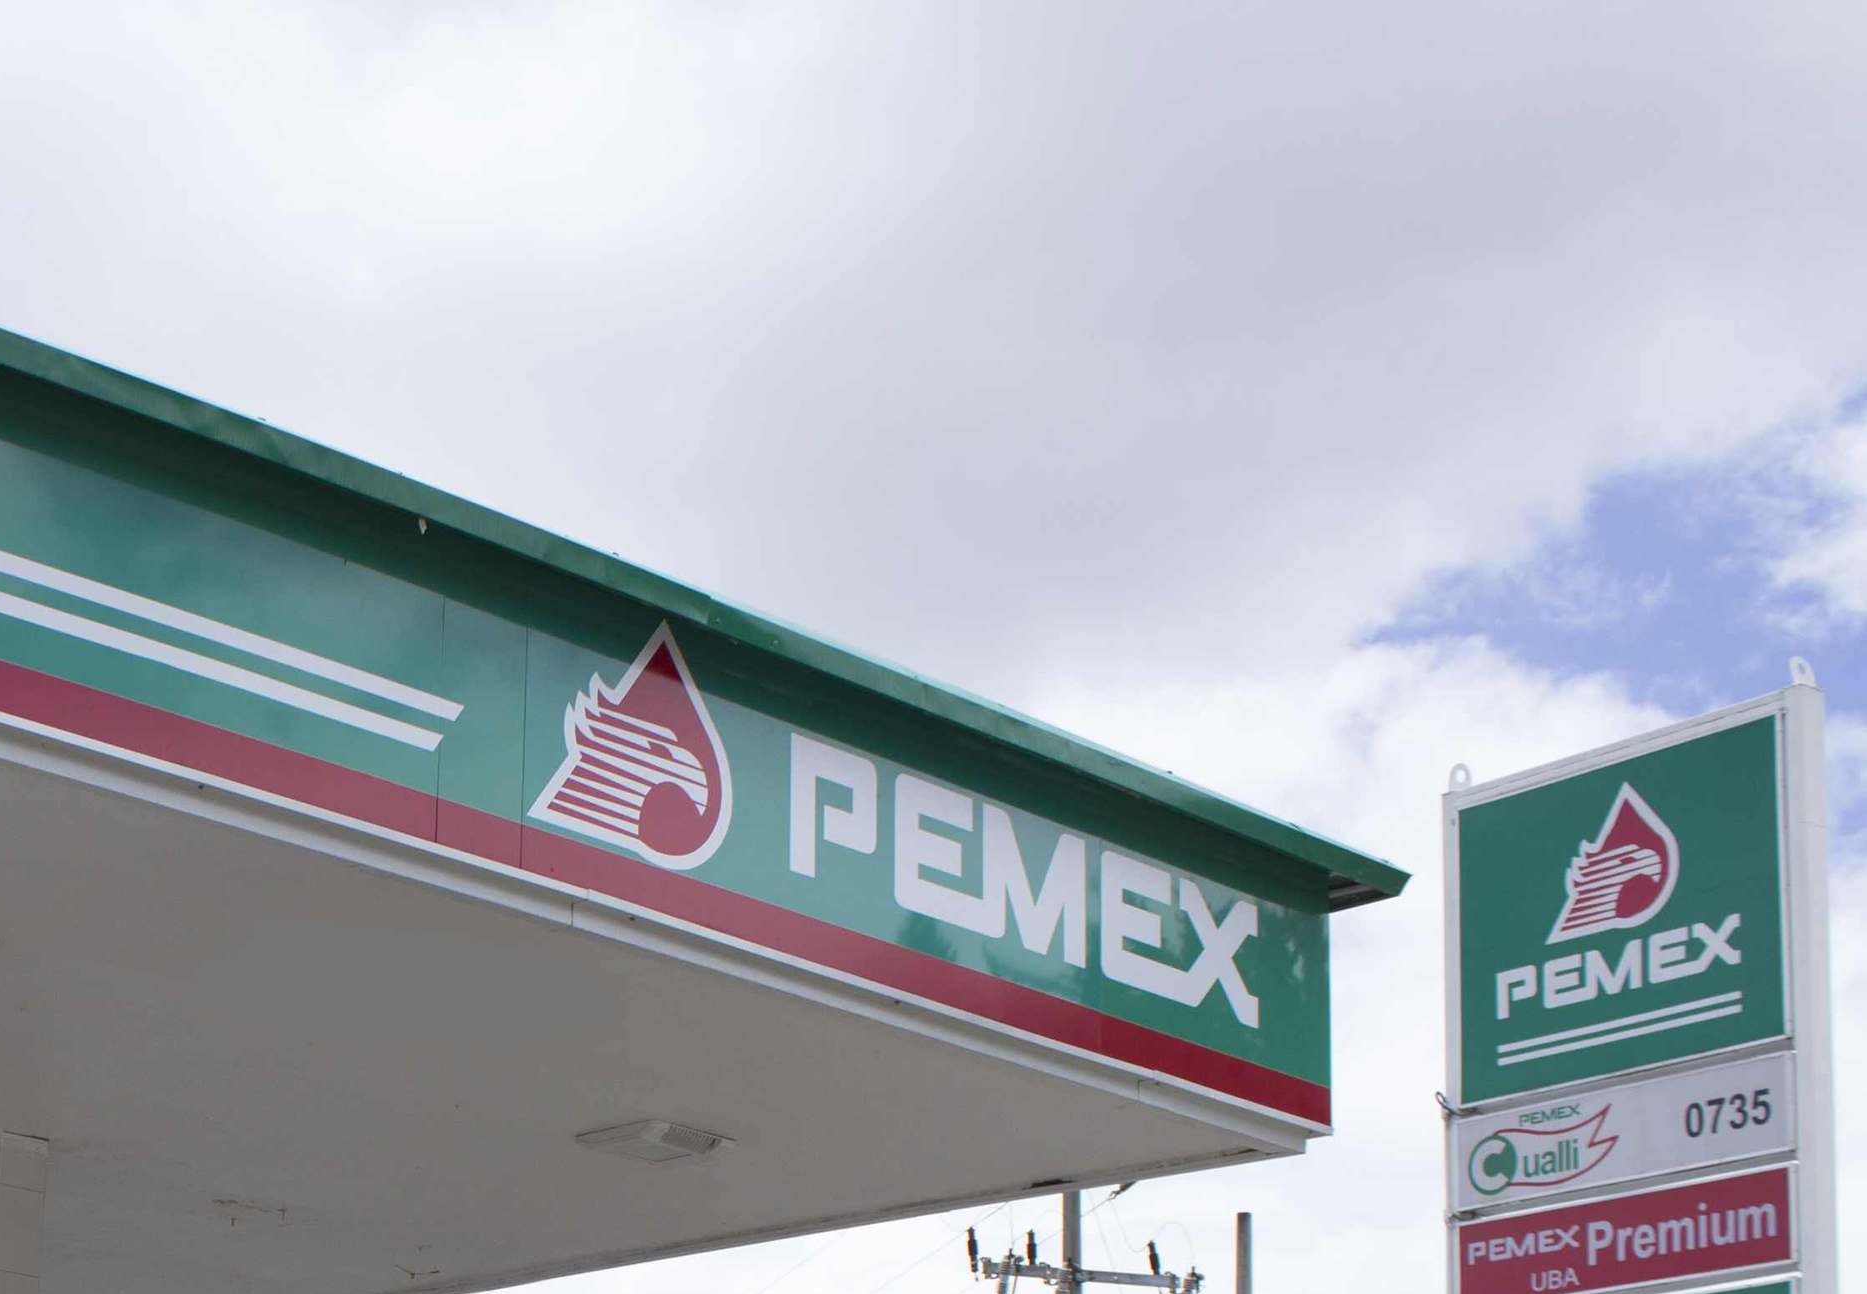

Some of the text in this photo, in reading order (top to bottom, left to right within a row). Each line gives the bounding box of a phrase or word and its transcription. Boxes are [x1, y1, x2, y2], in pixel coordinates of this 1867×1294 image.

[790, 733, 1258, 1027] PEMEX
[1496, 913, 1741, 1019] PEMEX
[1518, 1103, 1581, 1127] PEMEX
[1685, 1088, 1772, 1138] 0735
[1467, 1201, 1777, 1266] PEMEX Premium
[1530, 1267, 1580, 1292] UBA
